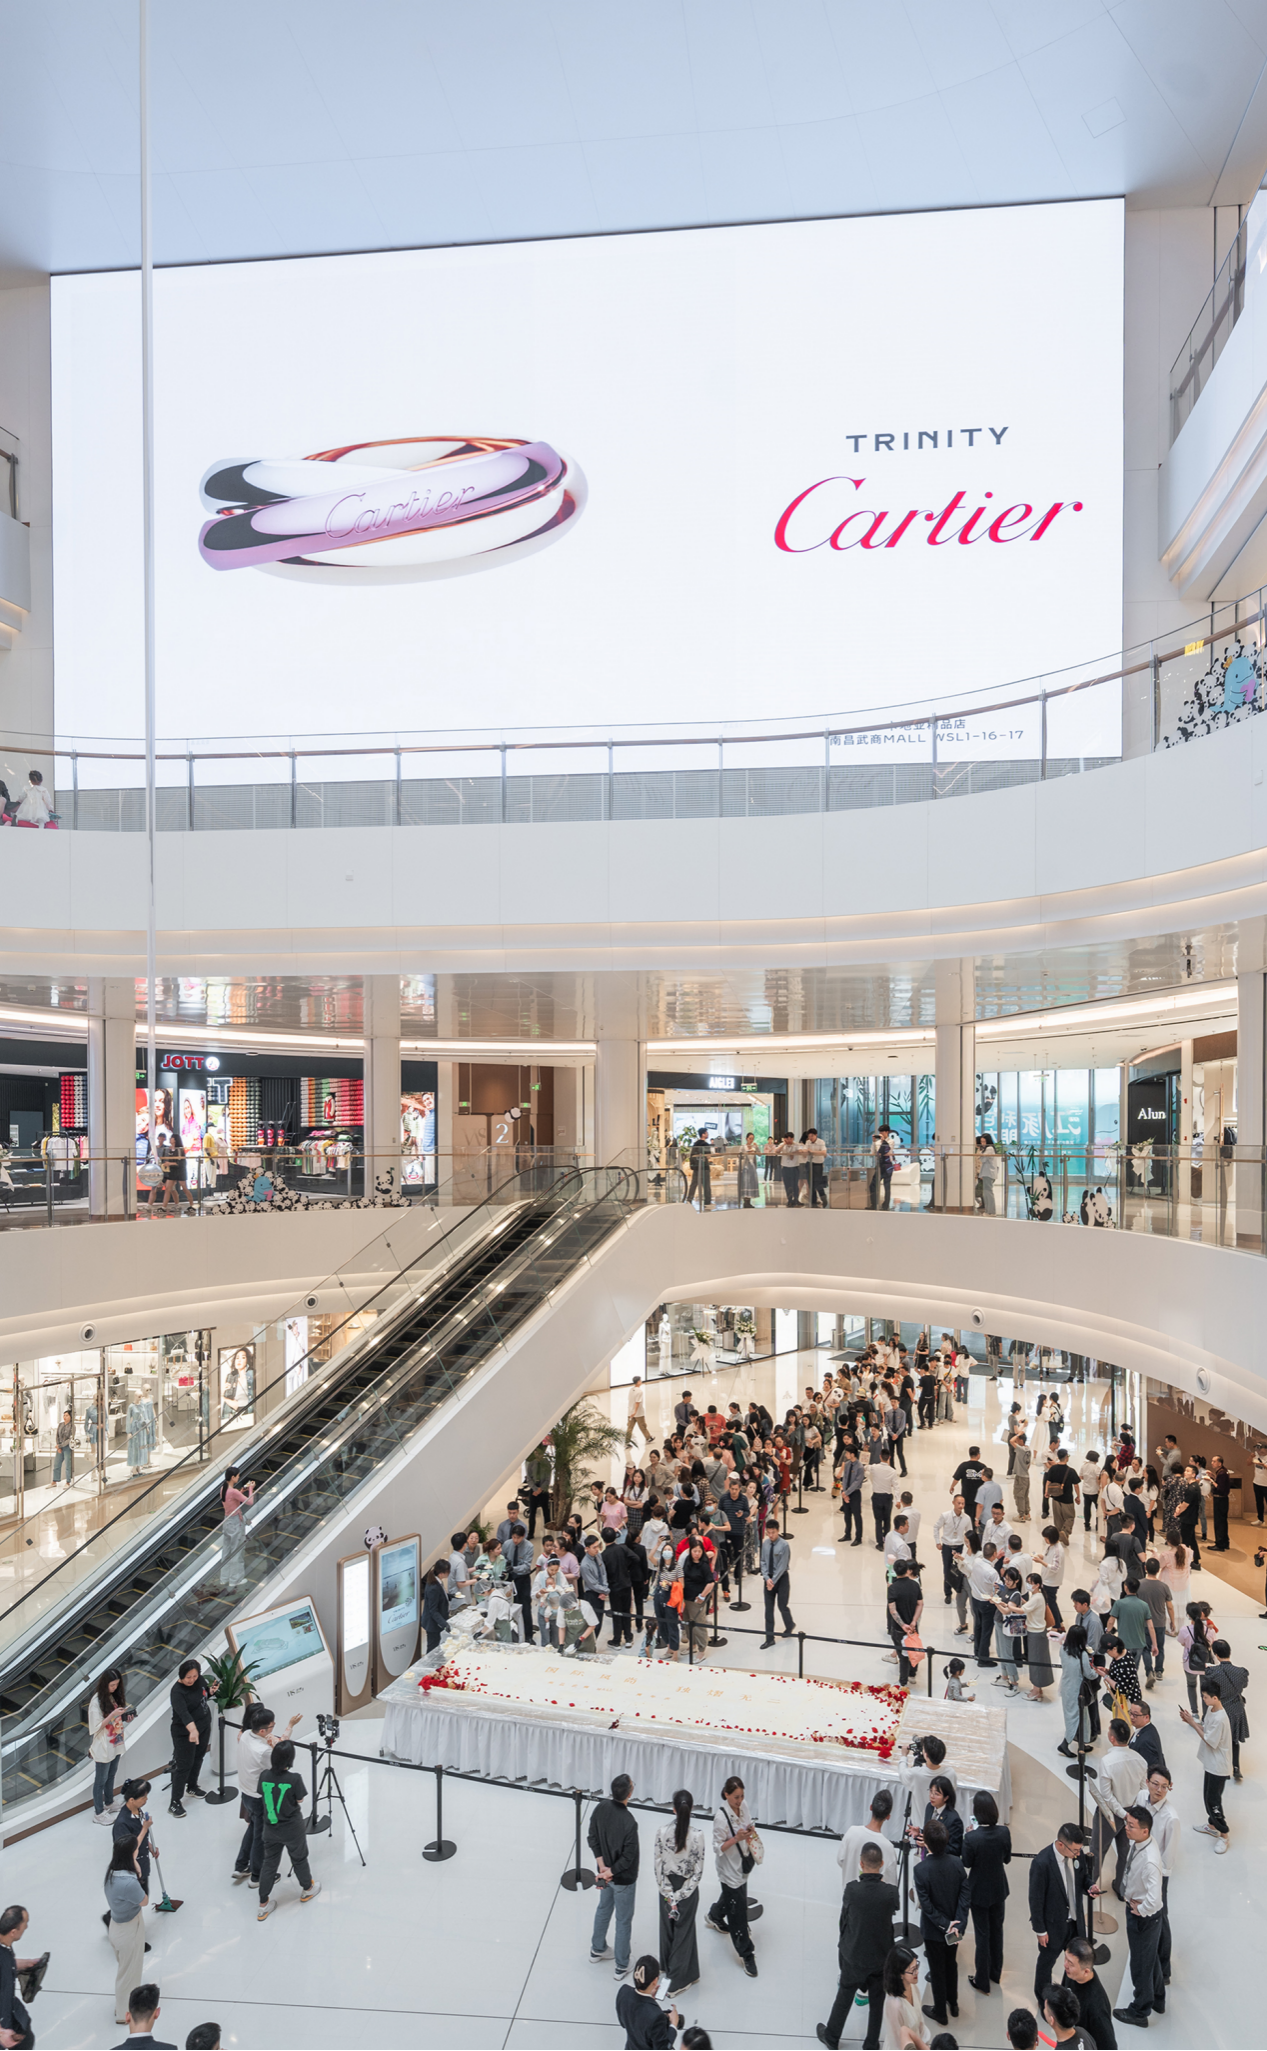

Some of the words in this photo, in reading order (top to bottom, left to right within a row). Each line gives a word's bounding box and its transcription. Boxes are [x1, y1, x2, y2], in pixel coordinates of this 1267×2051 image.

[845, 426, 1009, 452] TRINITY
[324, 483, 476, 540] Cartier
[773, 476, 1084, 553] Cartier
[829, 733, 926, 746] 南昌武商MALL
[162, 1055, 205, 1069] JOTT
[495, 1123, 509, 1144] 2
